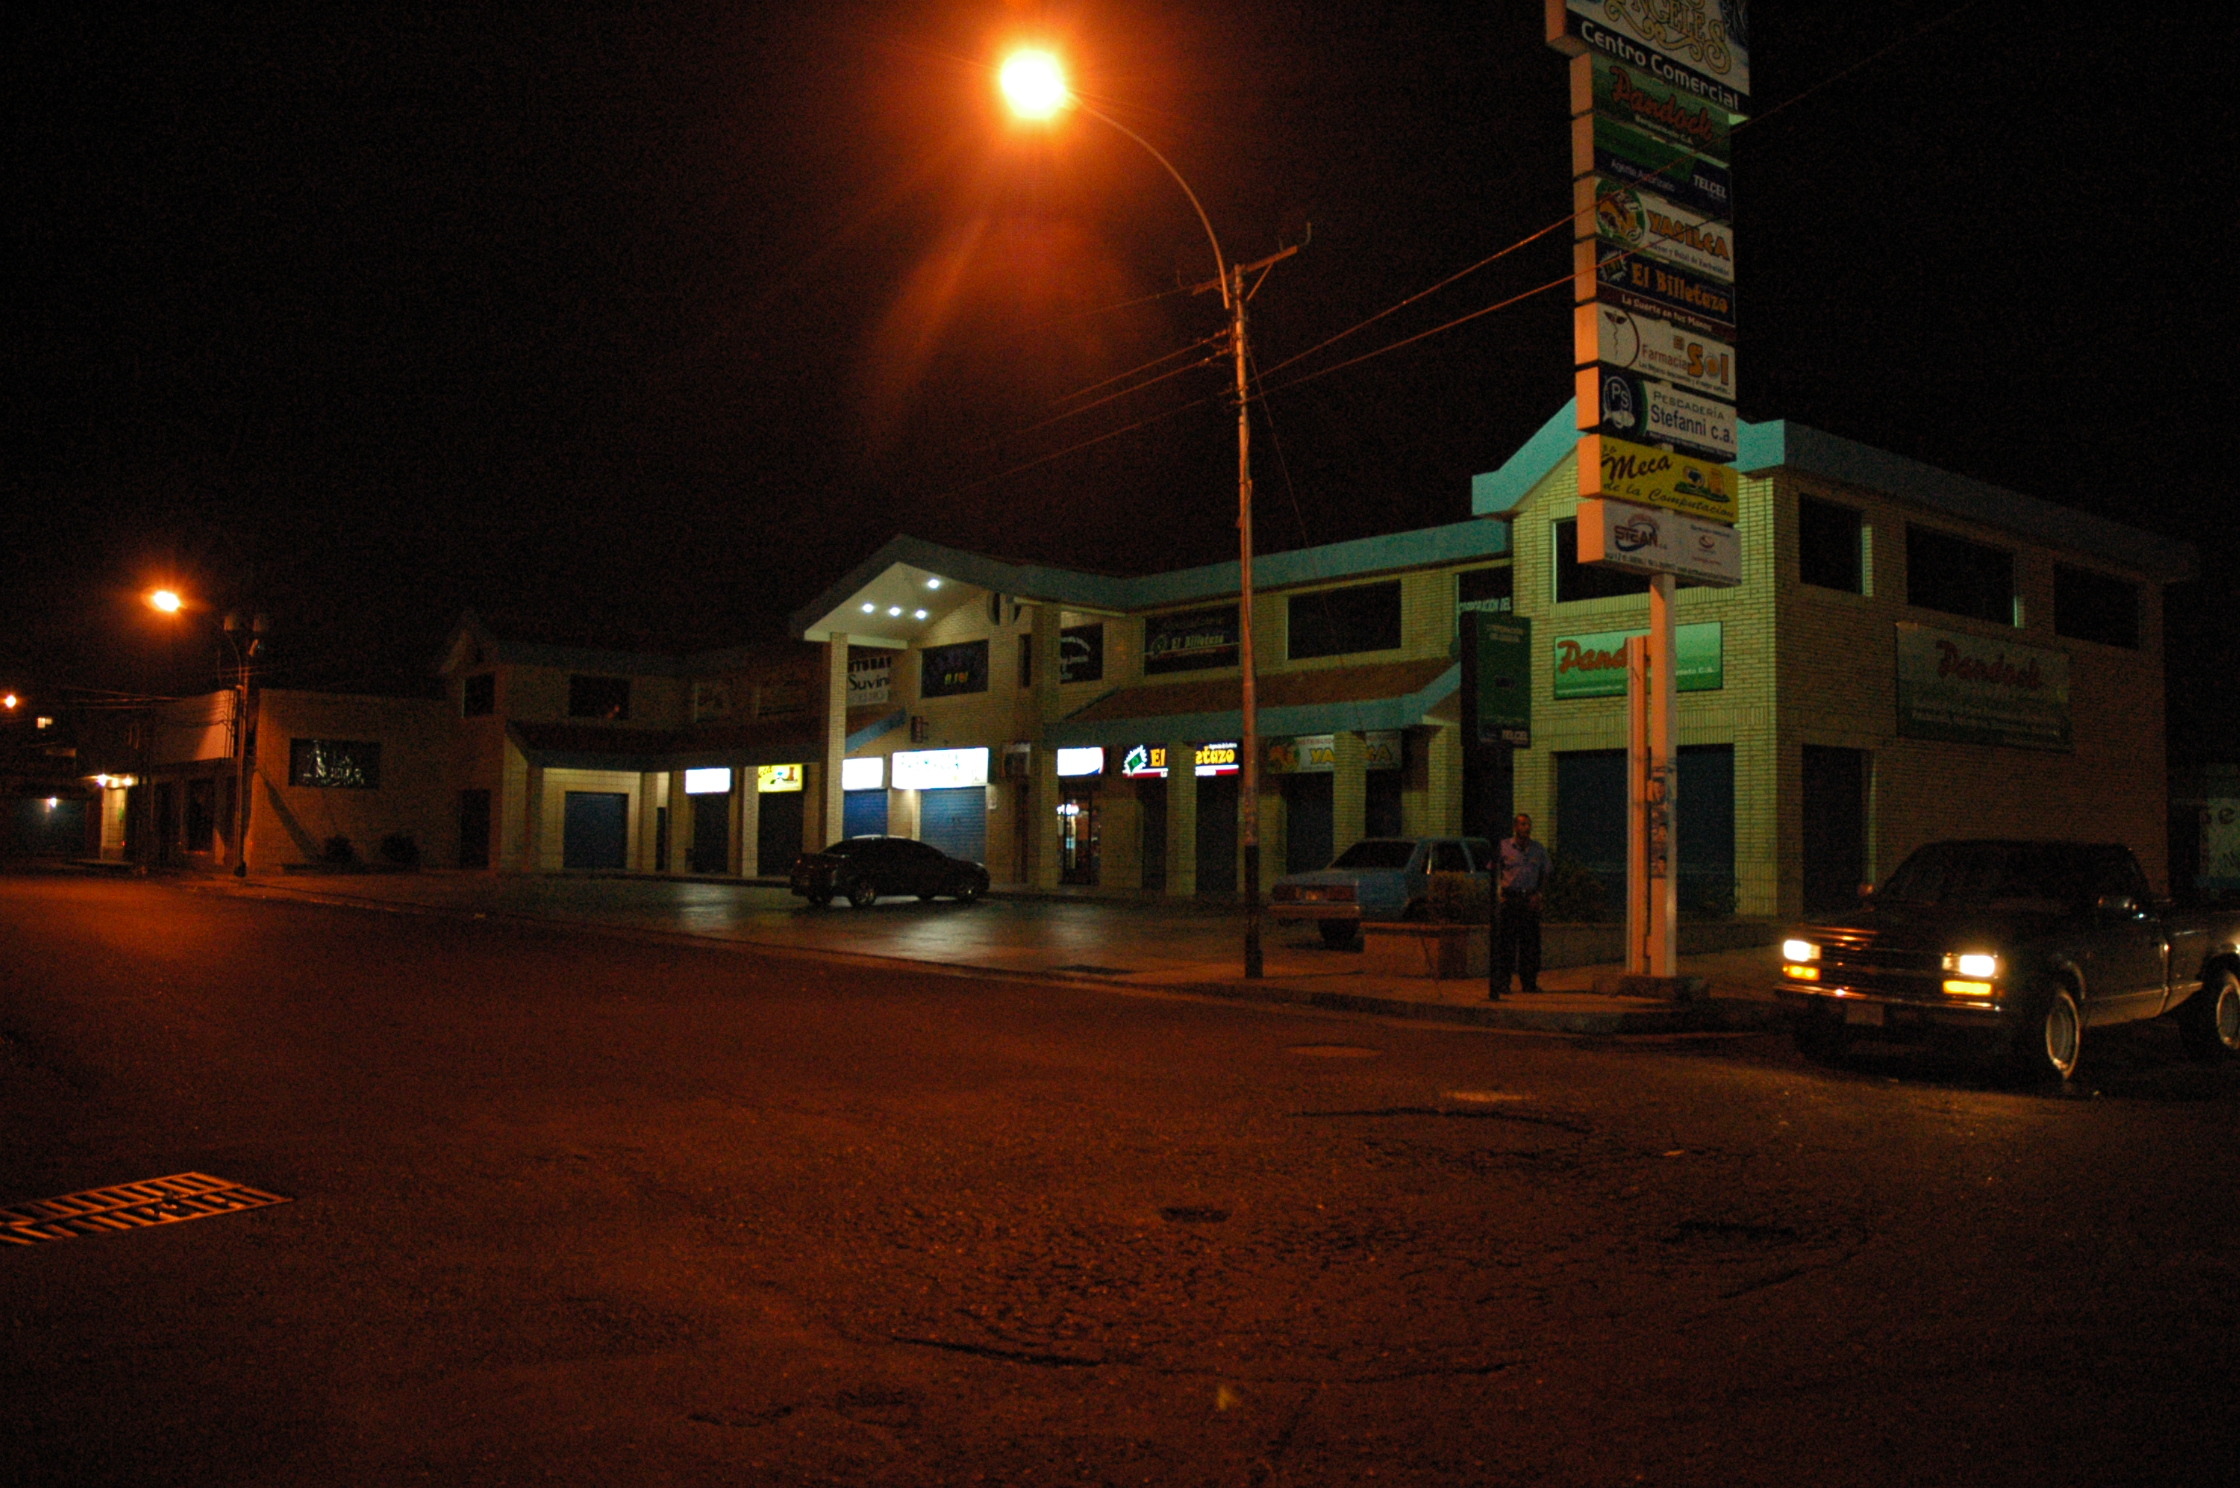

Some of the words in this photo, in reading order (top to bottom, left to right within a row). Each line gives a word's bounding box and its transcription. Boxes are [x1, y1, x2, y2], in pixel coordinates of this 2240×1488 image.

[1580, 20, 1647, 67] Centro
[1650, 52, 1738, 111] Comercial
[1693, 174, 1727, 198] TELCEL
[1631, 262, 1649, 288] El
[1651, 404, 1706, 437] Stefanni
[1602, 454, 1671, 480] Meca
[1150, 748, 1166, 767] El
